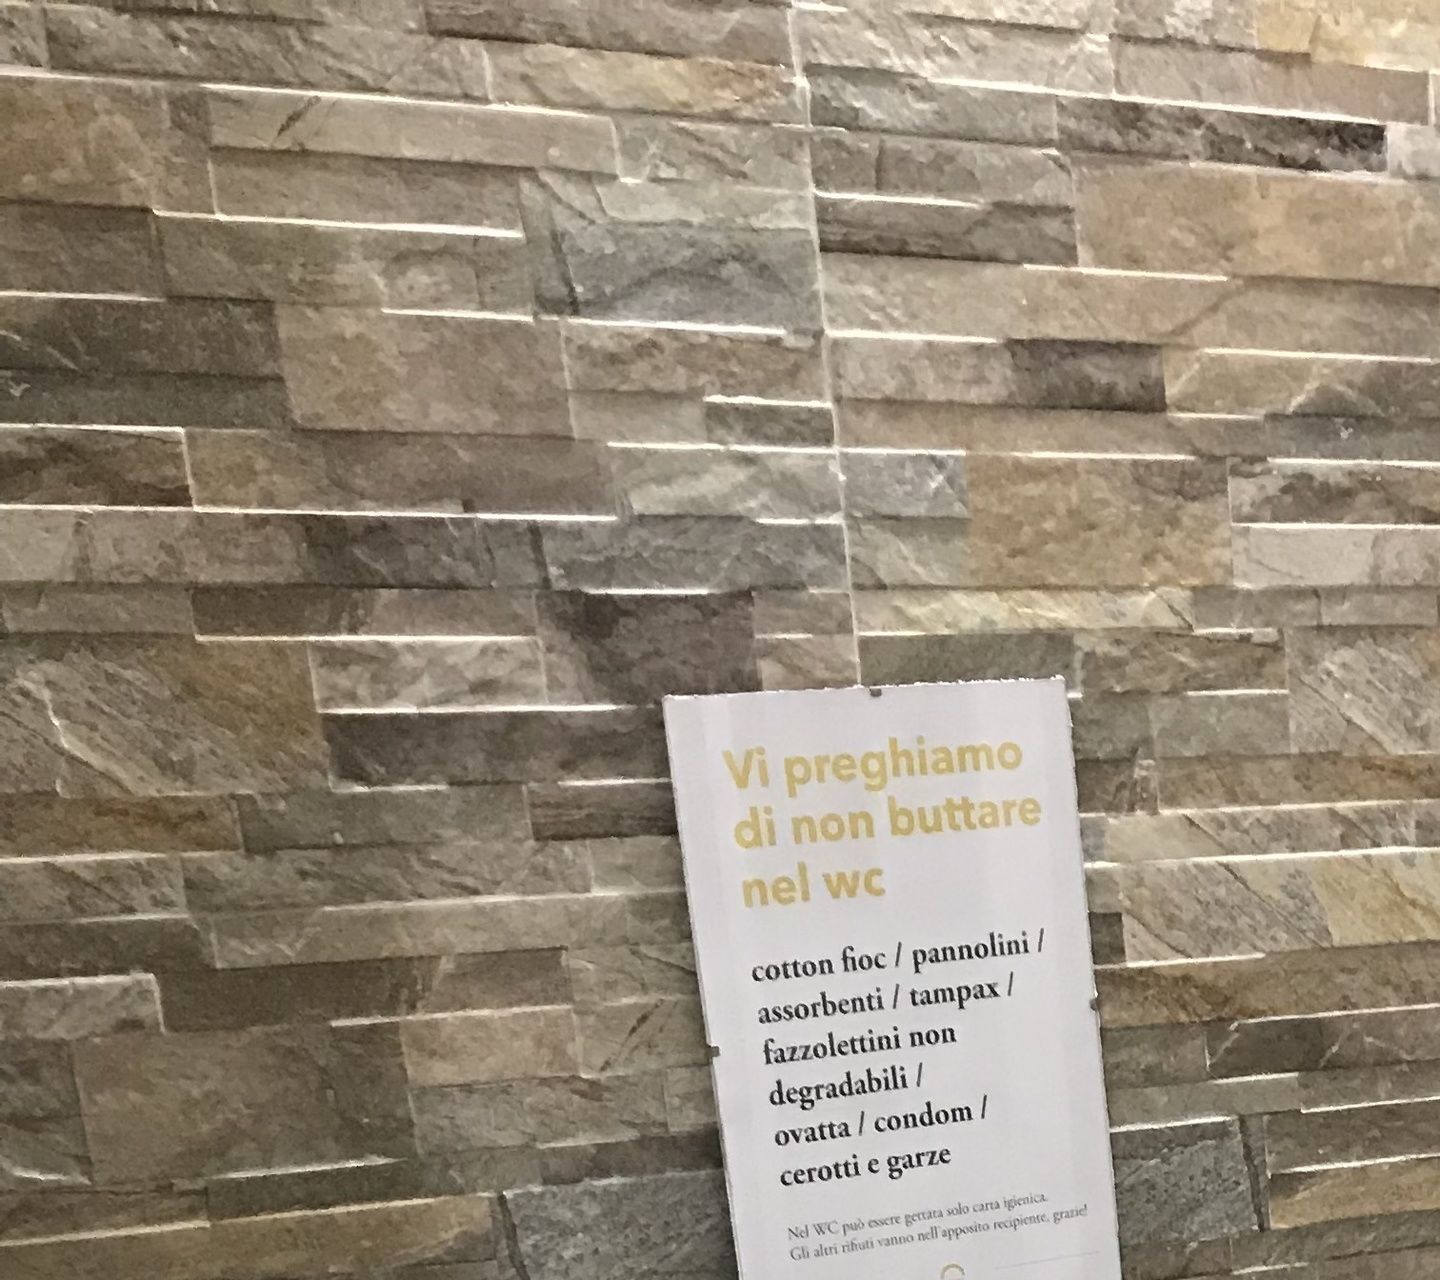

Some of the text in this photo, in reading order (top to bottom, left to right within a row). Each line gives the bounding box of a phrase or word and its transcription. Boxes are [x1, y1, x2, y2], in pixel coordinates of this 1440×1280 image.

[723, 736, 1023, 798] Vi preghiamo
[734, 795, 1042, 849] di non buttare
[741, 862, 886, 908] nel wc
[751, 928, 1045, 983] cotton fioc / pannolini /
[758, 971, 1014, 1024] assorbenti / tampax /
[763, 1024, 957, 1066] fazzolettini non
[769, 1062, 923, 1110] degradabili /
[774, 1095, 987, 1147] ovatta / condom /
[780, 1147, 952, 1187] cerotti e garze
[788, 1224, 809, 1240] Nel
[812, 1220, 839, 1236] WC
[842, 1218, 865, 1236] può
[868, 1215, 901, 1229] essere
[904, 1208, 943, 1227] gettata
[946, 1202, 969, 1217] solo
[973, 1199, 1000, 1213] carta
[790, 1246, 809, 1261] Gli
[813, 1243, 838, 1258] altri
[842, 1238, 874, 1253] rifiuti
[877, 1234, 914, 1247] vanno
[1053, 1203, 1088, 1224] grazie!
